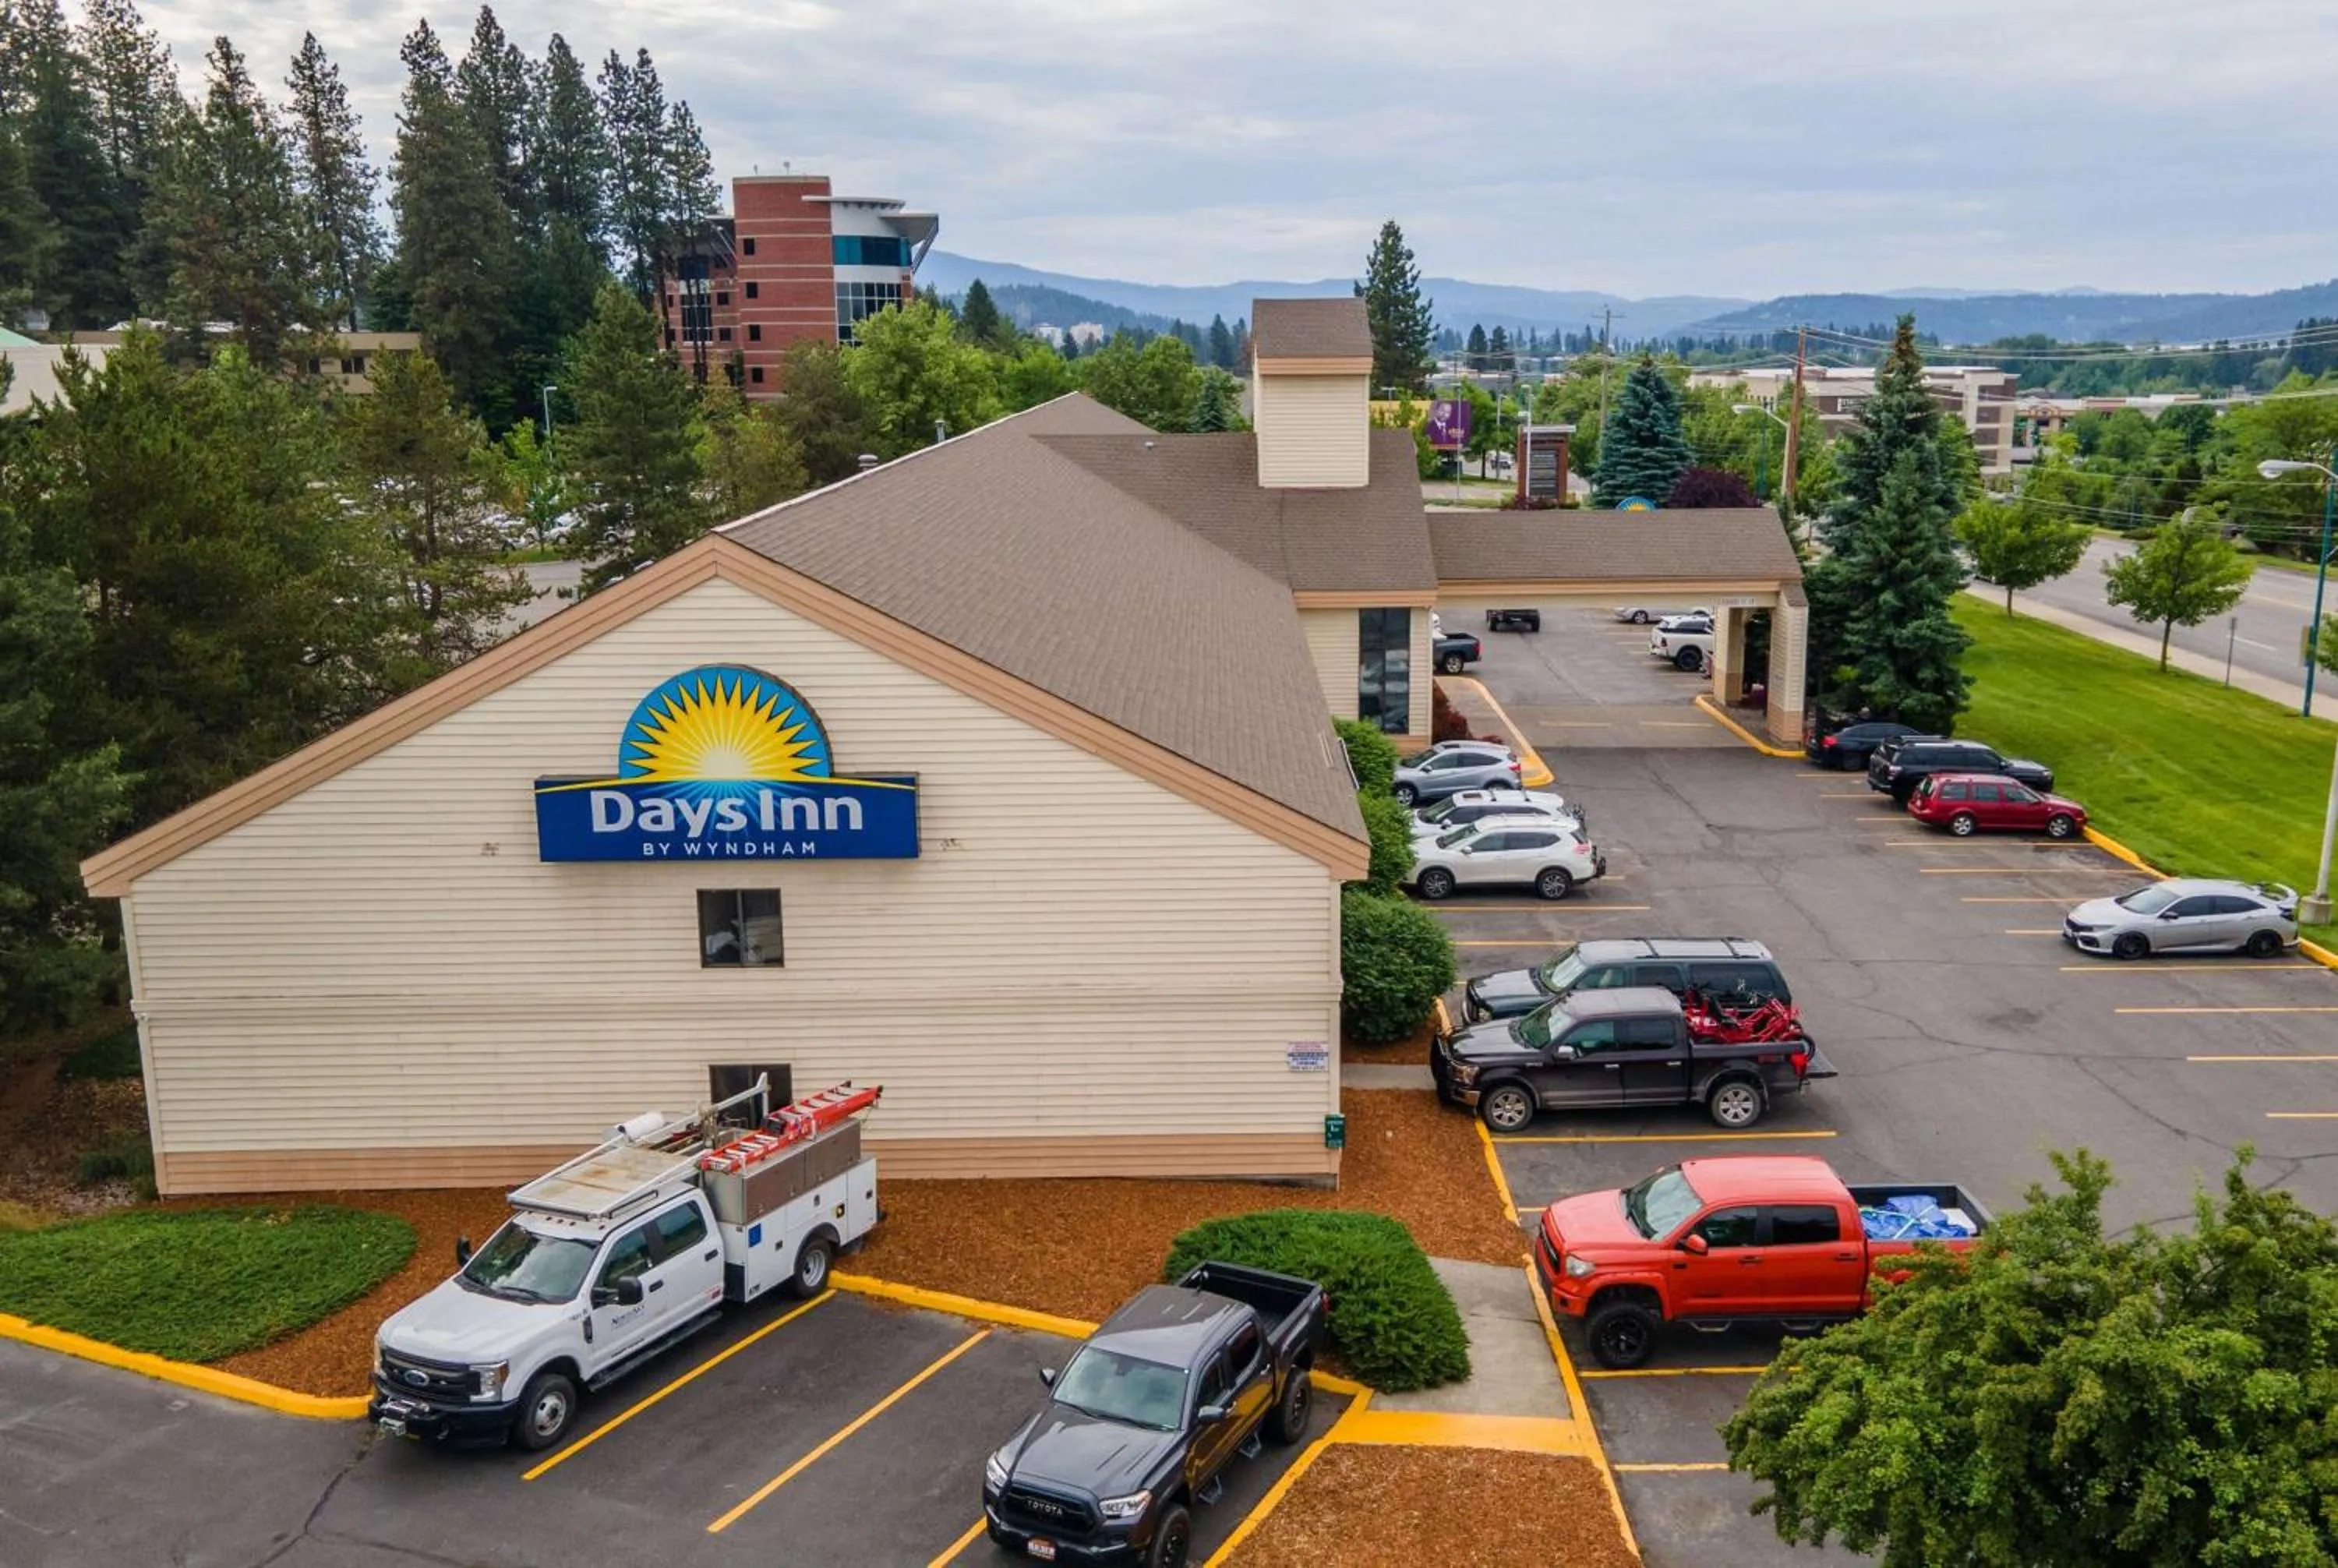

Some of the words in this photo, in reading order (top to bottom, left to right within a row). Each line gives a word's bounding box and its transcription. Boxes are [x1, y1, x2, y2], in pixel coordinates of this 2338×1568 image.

[590, 789, 748, 838] Days
[759, 788, 863, 831] Inn
[642, 842, 670, 855] BY
[683, 841, 816, 855] WYNDHAM
[1028, 1500, 1062, 1516] TOYOTA
